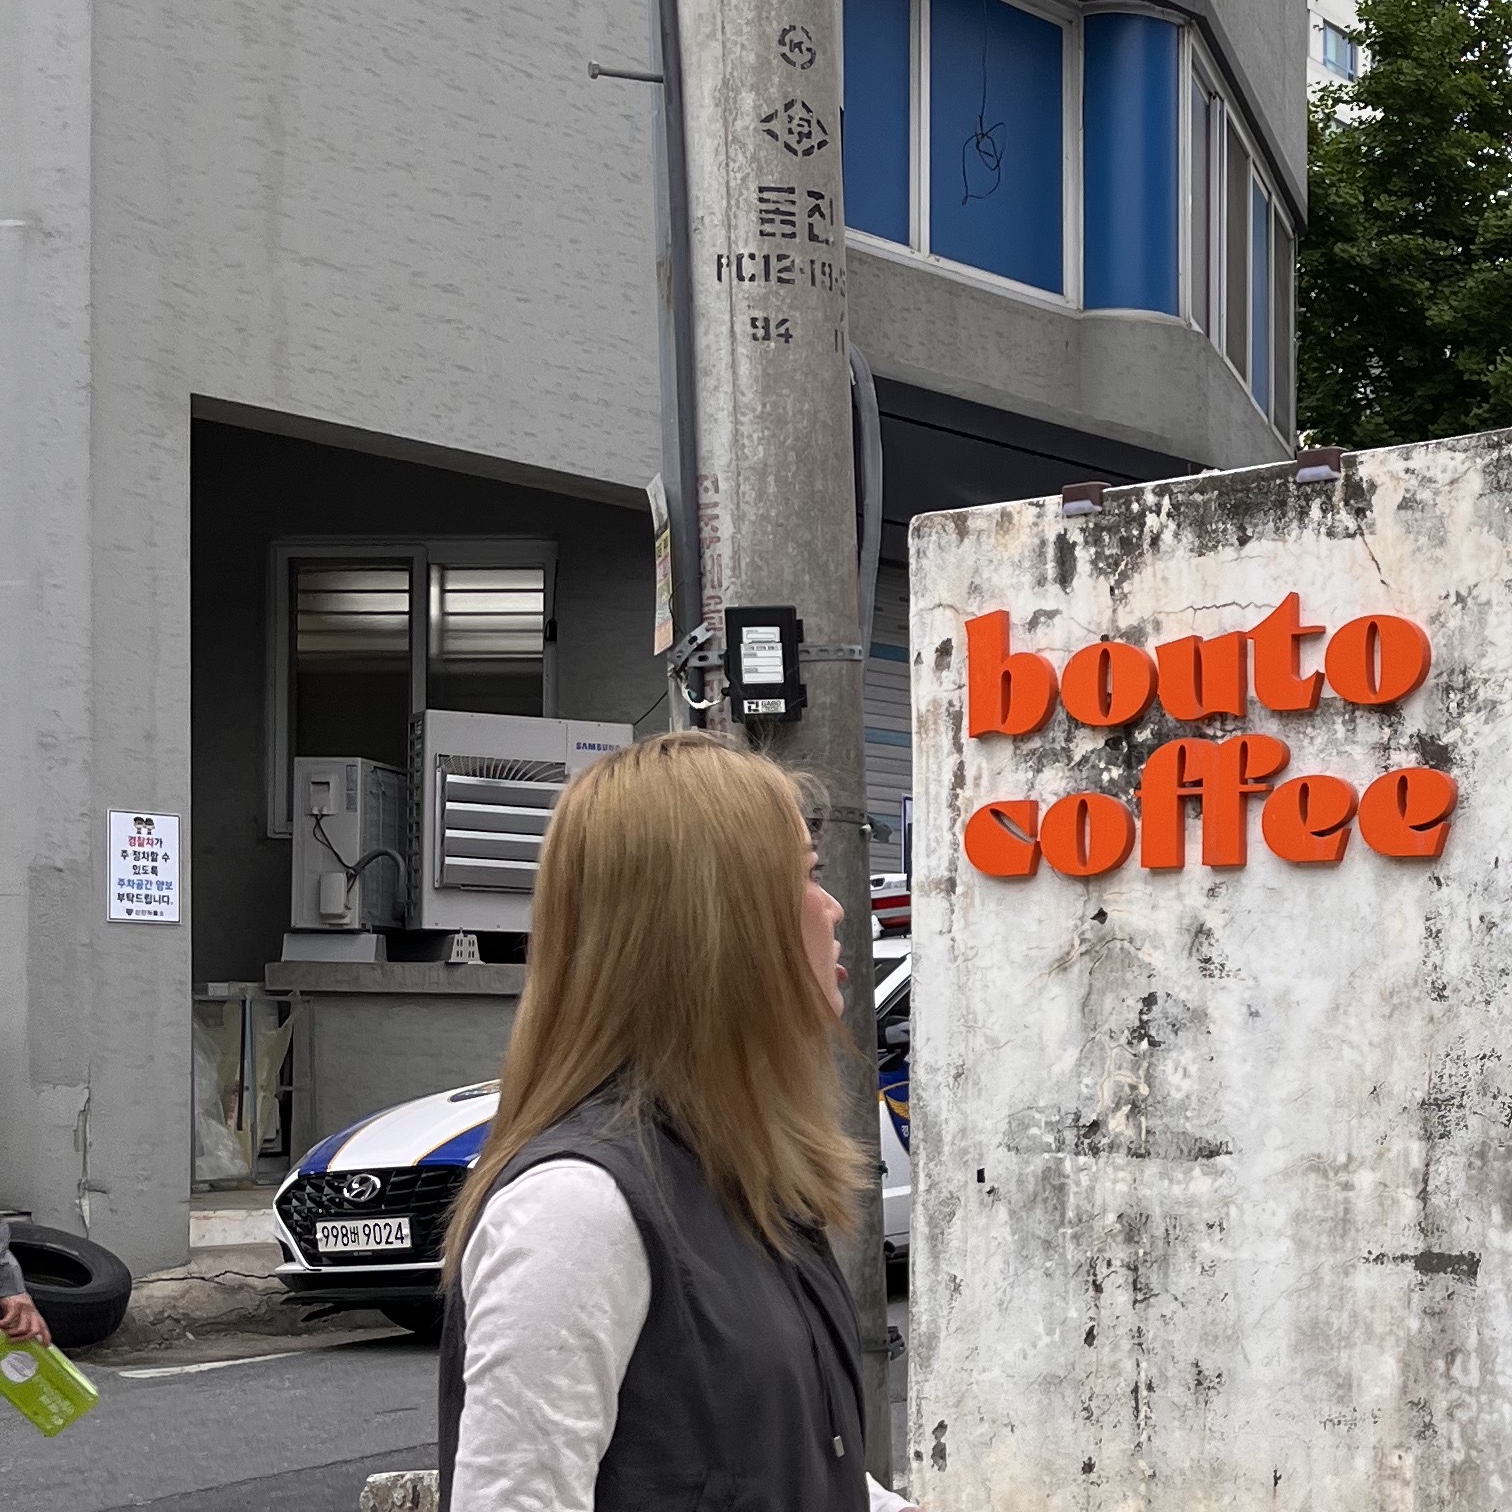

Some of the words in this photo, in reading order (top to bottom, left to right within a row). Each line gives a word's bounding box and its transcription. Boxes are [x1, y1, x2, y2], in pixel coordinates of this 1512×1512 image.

[964, 591, 1432, 738] bouto
[964, 733, 1458, 878] coffee
[128, 836, 162, 848] 경찰차가
[162, 852, 170, 863] 수
[132, 865, 158, 876] 있도록
[117, 878, 153, 891] 주차공간
[155, 880, 173, 891] 양보
[117, 893, 173, 905] 부탁드립니다.
[321, 1225, 360, 1247] 998버
[362, 1221, 405, 1245] 9024
